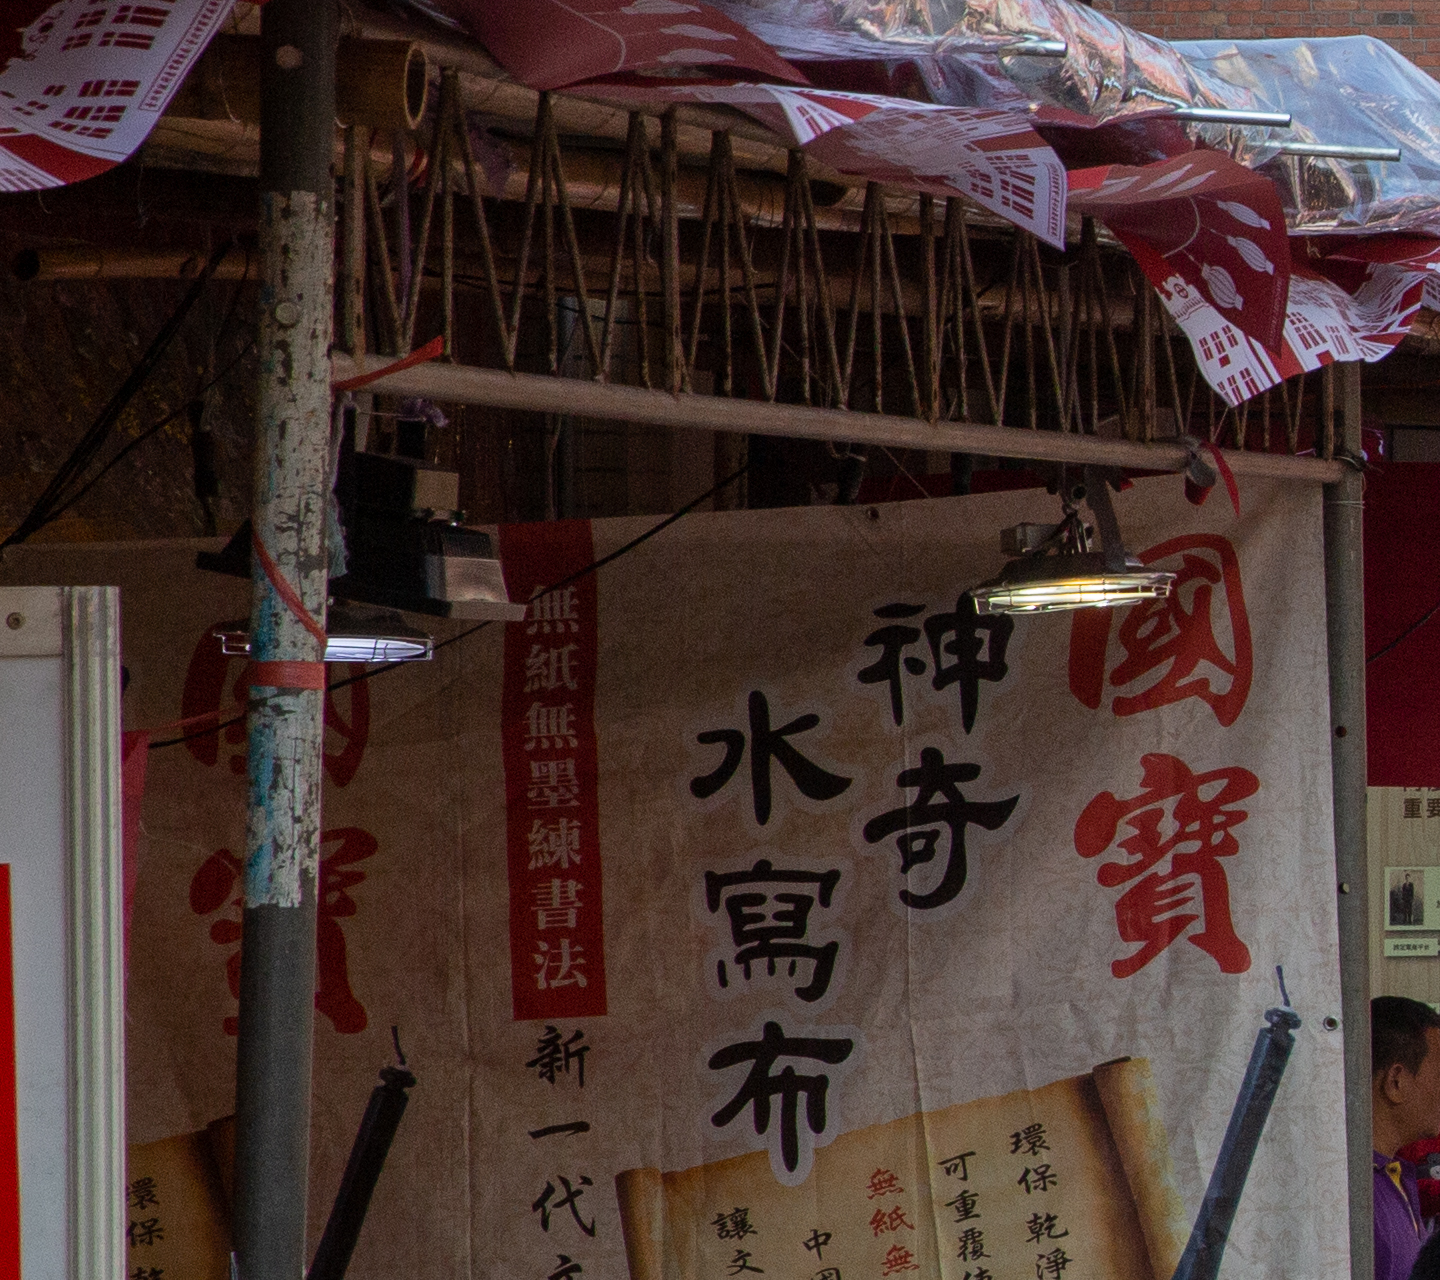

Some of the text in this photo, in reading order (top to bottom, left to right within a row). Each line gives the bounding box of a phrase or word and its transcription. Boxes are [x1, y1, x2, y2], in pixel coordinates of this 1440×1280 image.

[523, 583, 589, 990] 無紙無墨練書法
[857, 592, 1020, 910] 神奇
[1068, 533, 1260, 979] 國寶
[1009, 1122, 1060, 1195] 環保
